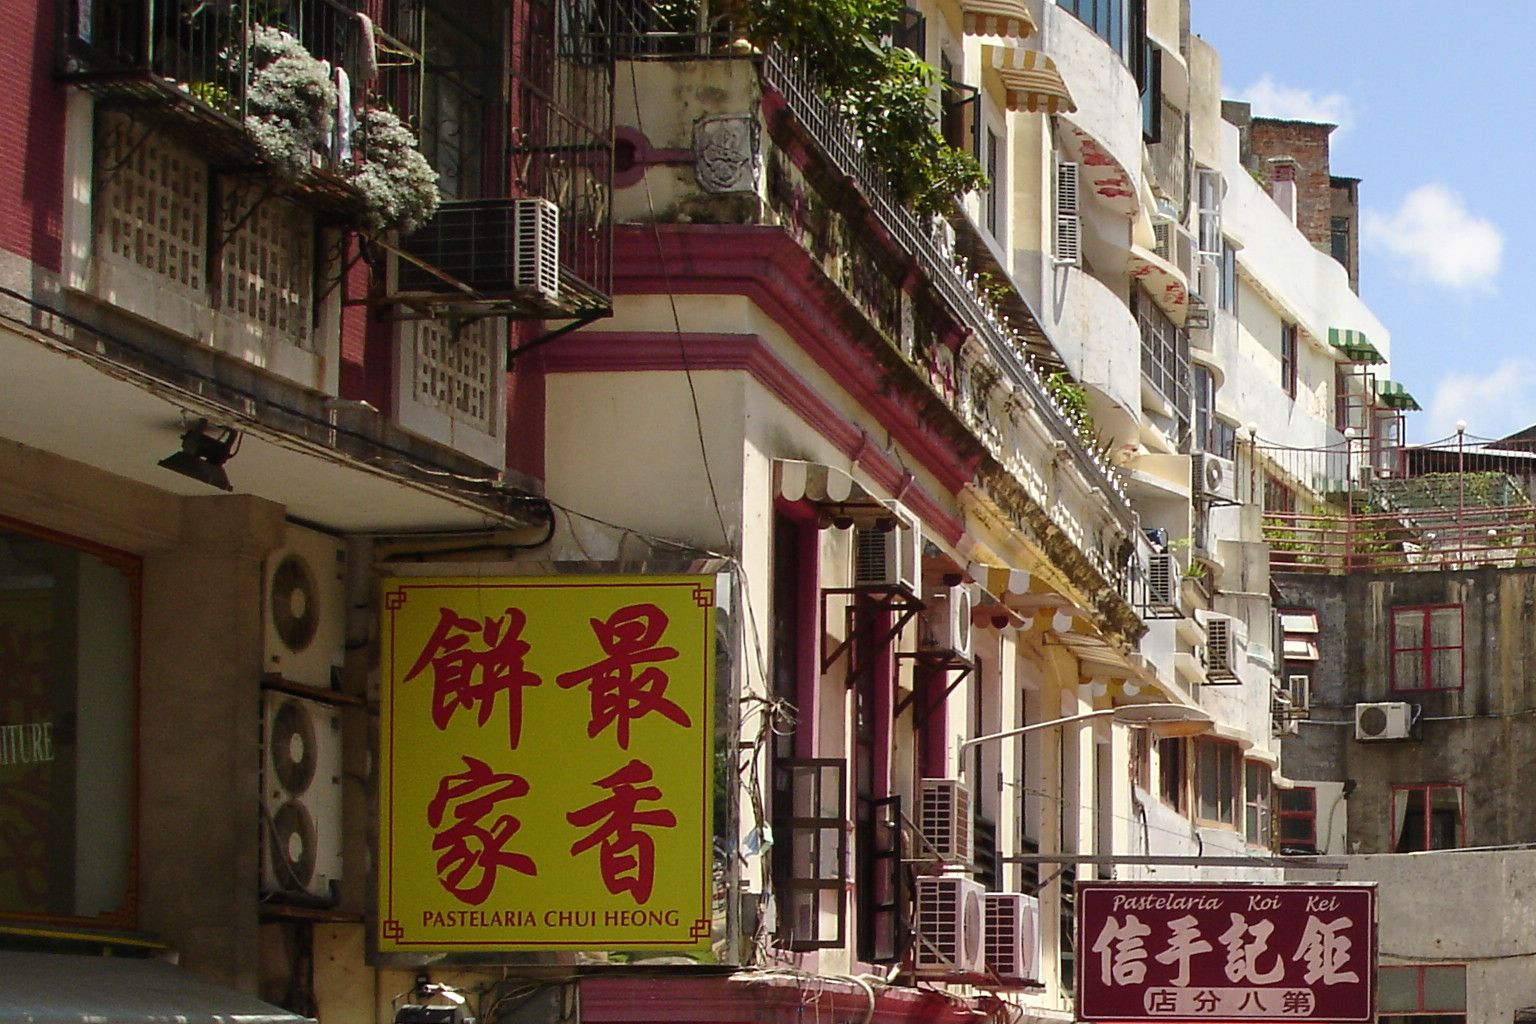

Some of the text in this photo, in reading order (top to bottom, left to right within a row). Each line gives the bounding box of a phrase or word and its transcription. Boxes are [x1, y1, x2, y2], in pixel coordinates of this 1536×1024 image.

[0, 722, 54, 765] ITURE
[1113, 893, 1340, 912] Pastelaria Koi Kei
[423, 910, 680, 927] PASTELARIA CHUI HEONG
